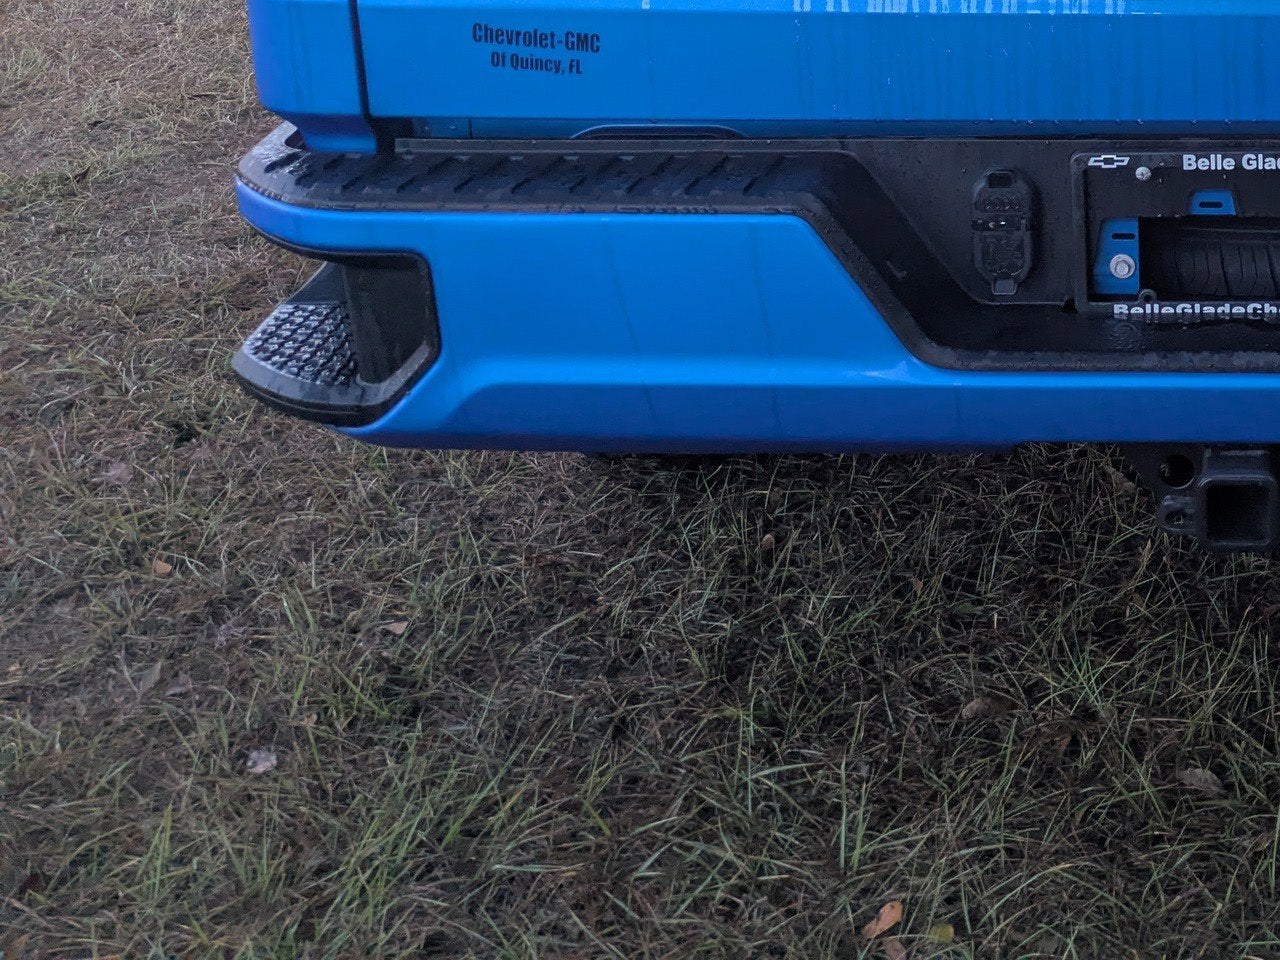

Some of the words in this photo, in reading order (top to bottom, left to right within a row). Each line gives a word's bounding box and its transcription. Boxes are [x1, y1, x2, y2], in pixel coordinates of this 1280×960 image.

[471, 22, 601, 54] Chevrolet-GMC
[490, 51, 507, 68] Of
[509, 53, 565, 76] Quincy,
[568, 58, 583, 75] FL
[1182, 154, 1235, 171] Belle
